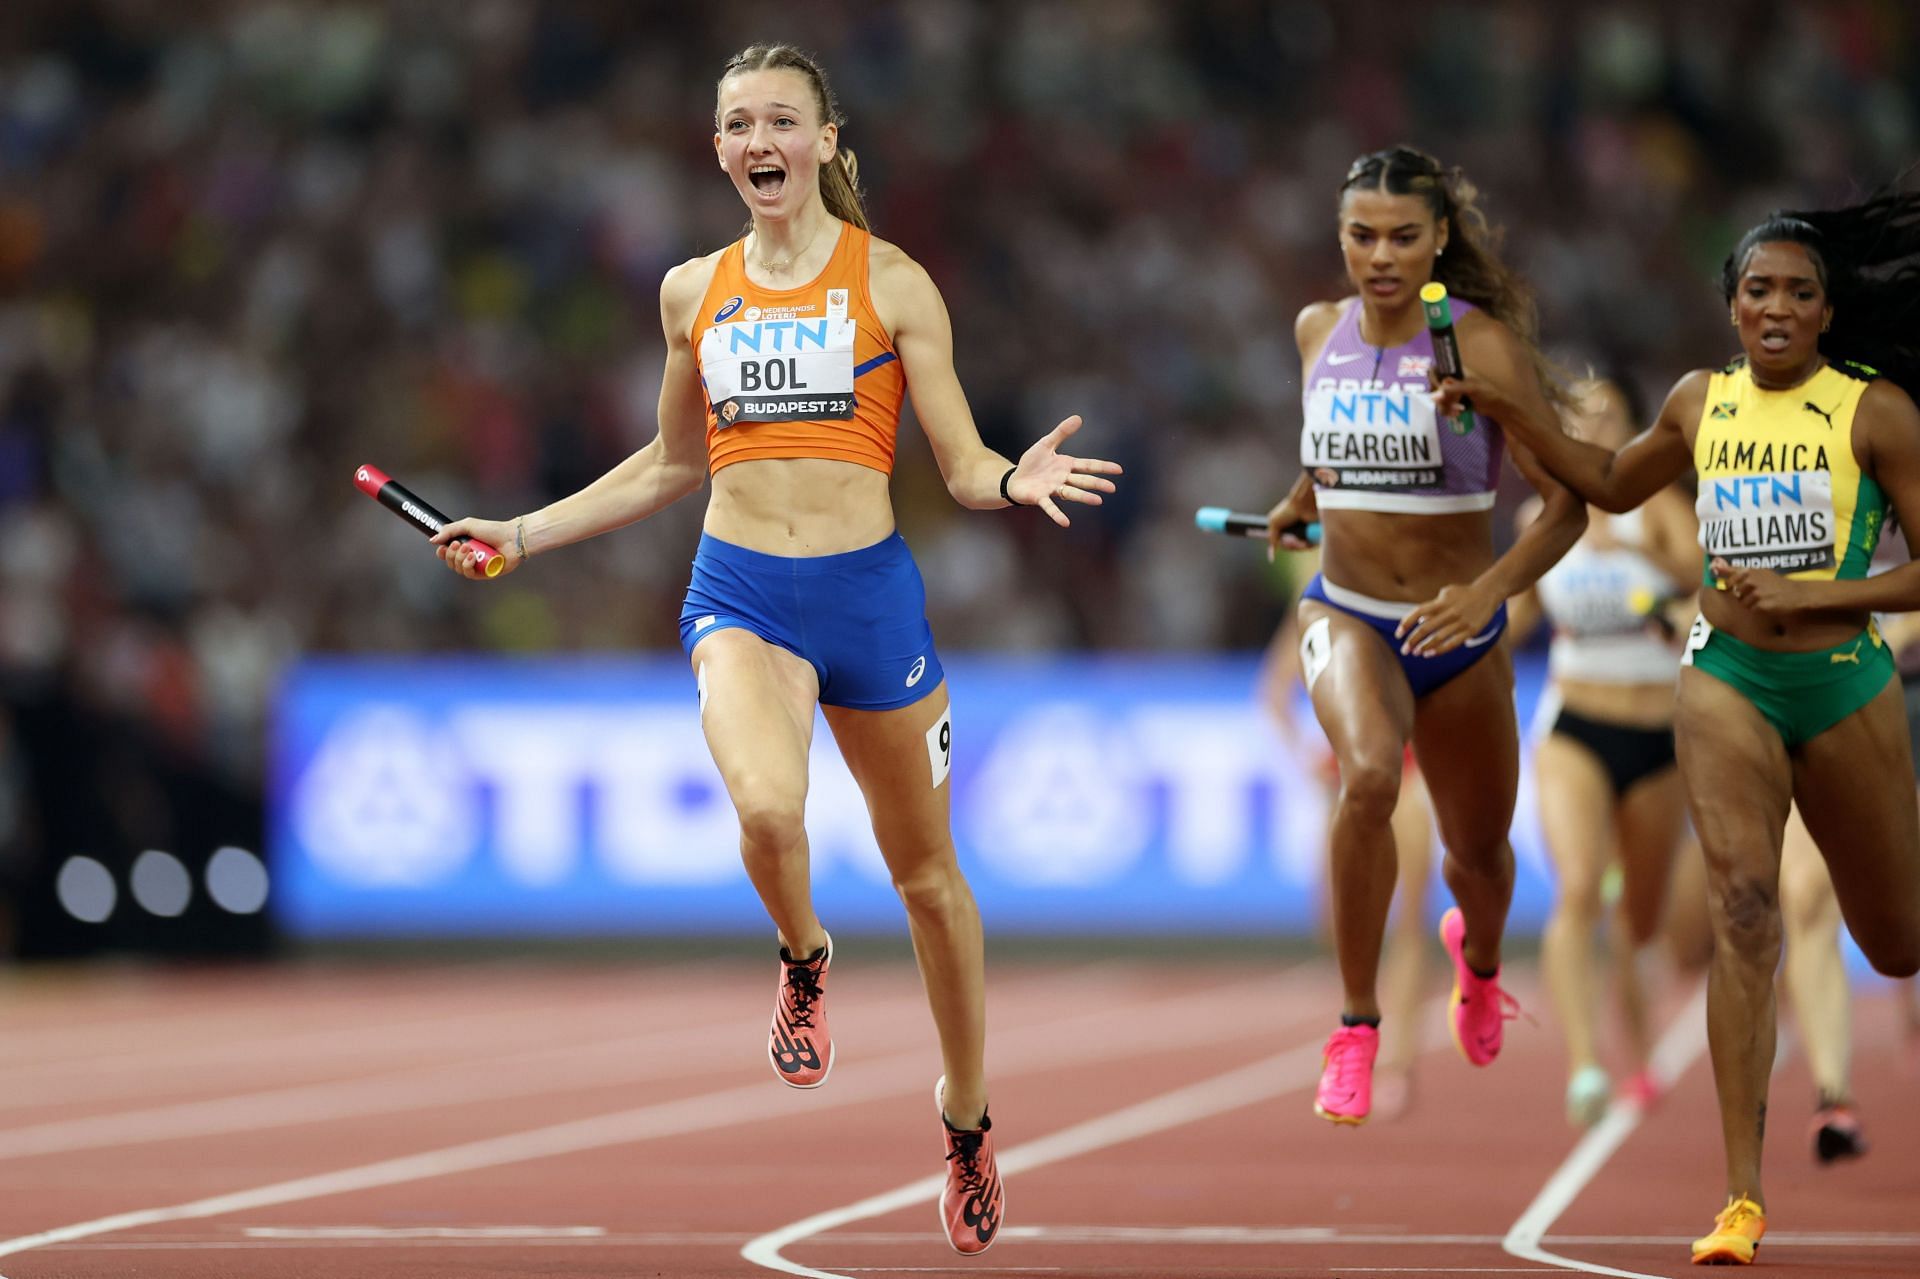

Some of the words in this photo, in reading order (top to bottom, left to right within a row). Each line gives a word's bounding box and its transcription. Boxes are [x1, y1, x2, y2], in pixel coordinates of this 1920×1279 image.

[761, 304, 817, 314] NEDERLANDSE
[730, 320, 828, 355] NTN
[740, 357, 807, 392] BOL
[744, 401, 828, 414] BUDAPEST
[829, 400, 847, 413] 23
[1330, 393, 1410, 426] NTN
[1311, 432, 1431, 462] YEARGIN
[1704, 439, 1830, 473] JAMAICA
[1341, 470, 1417, 486] BUDAPEST
[1714, 474, 1803, 512] NTN
[401, 500, 439, 530] MONDO
[1704, 511, 1827, 550] WILLIAMS
[1731, 553, 1809, 570] BUDAPEST
[939, 720, 950, 767] 9
